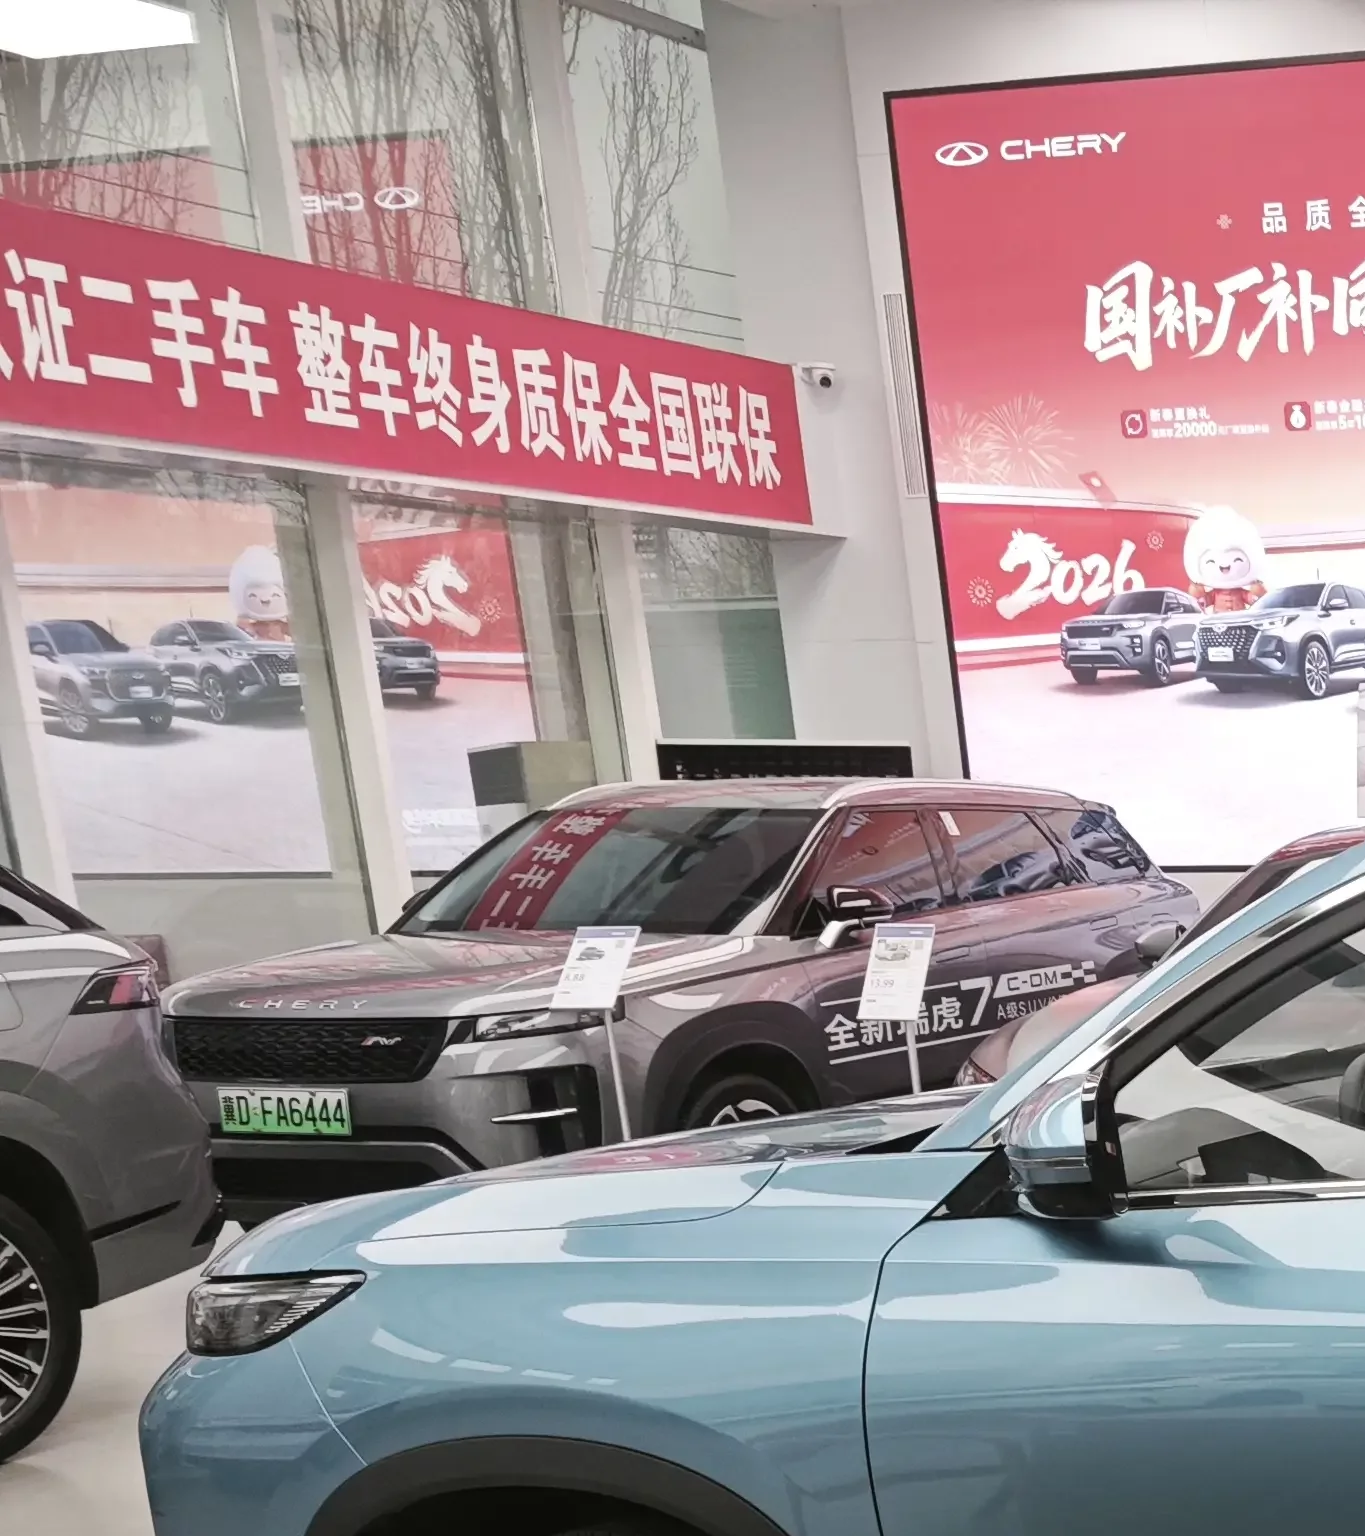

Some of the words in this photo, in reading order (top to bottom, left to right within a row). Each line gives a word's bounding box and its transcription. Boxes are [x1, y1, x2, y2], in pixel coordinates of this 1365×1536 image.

[1000, 132, 1126, 161] CHERY
[0, 248, 279, 418] 证二手车
[288, 301, 783, 490] 整车终身质保全国联保
[996, 528, 1146, 620] 2026
[1007, 971, 1058, 991] C-DM
[238, 999, 368, 1010] CHERY
